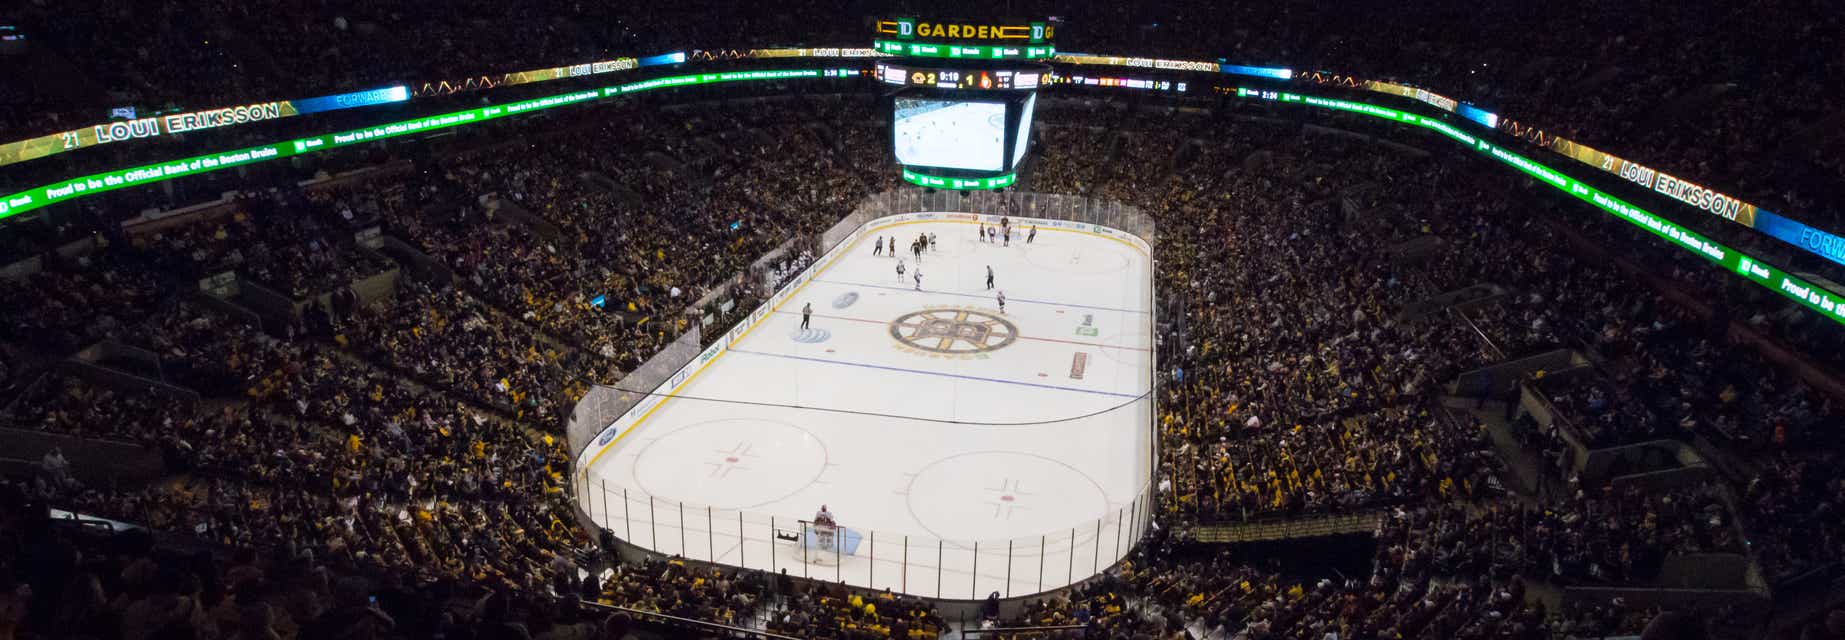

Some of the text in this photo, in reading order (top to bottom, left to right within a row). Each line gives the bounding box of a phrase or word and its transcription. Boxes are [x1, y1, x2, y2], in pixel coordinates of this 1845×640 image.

[899, 21, 1004, 39] TD GARDEN
[1032, 26, 1043, 39] TD
[1155, 60, 1212, 72] ERIKSSON
[927, 73, 935, 84] 2
[966, 74, 973, 86] 1
[62, 101, 280, 149] 21 LOUI ERIKSSON
[1603, 155, 1741, 221] 21 LOUI ERIKSSON
[1801, 226, 1845, 261] FORW
[1781, 278, 1810, 299] Proud
[1809, 291, 1820, 304] to
[1820, 296, 1835, 312] be
